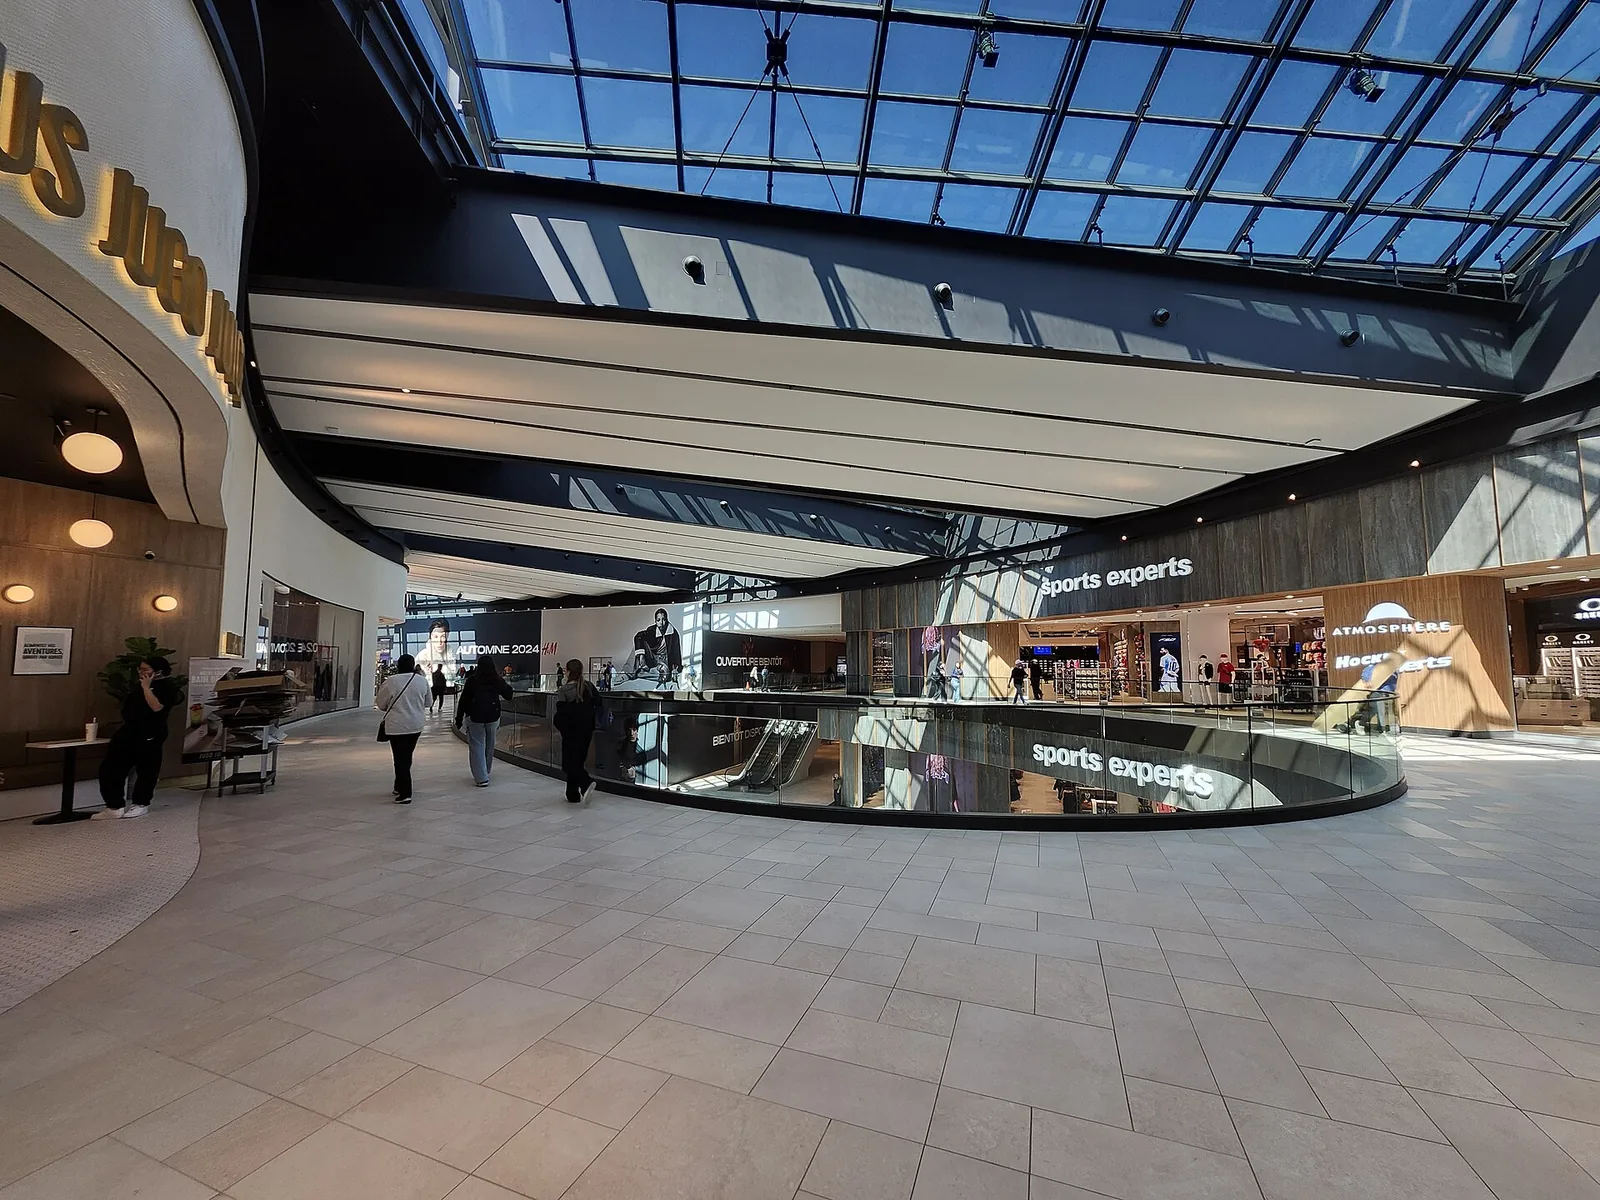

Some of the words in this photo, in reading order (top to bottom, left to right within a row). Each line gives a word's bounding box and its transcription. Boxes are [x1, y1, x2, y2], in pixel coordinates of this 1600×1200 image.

[1040, 571, 1102, 598] sports
[1106, 556, 1194, 588] experts
[456, 644, 510, 655] AUTOMNE
[511, 644, 540, 654] 2024
[715, 656, 758, 667] OUVERTURE
[758, 655, 783, 666] BIENTÔT
[1032, 743, 1104, 772] sports
[1108, 755, 1214, 800] experts
